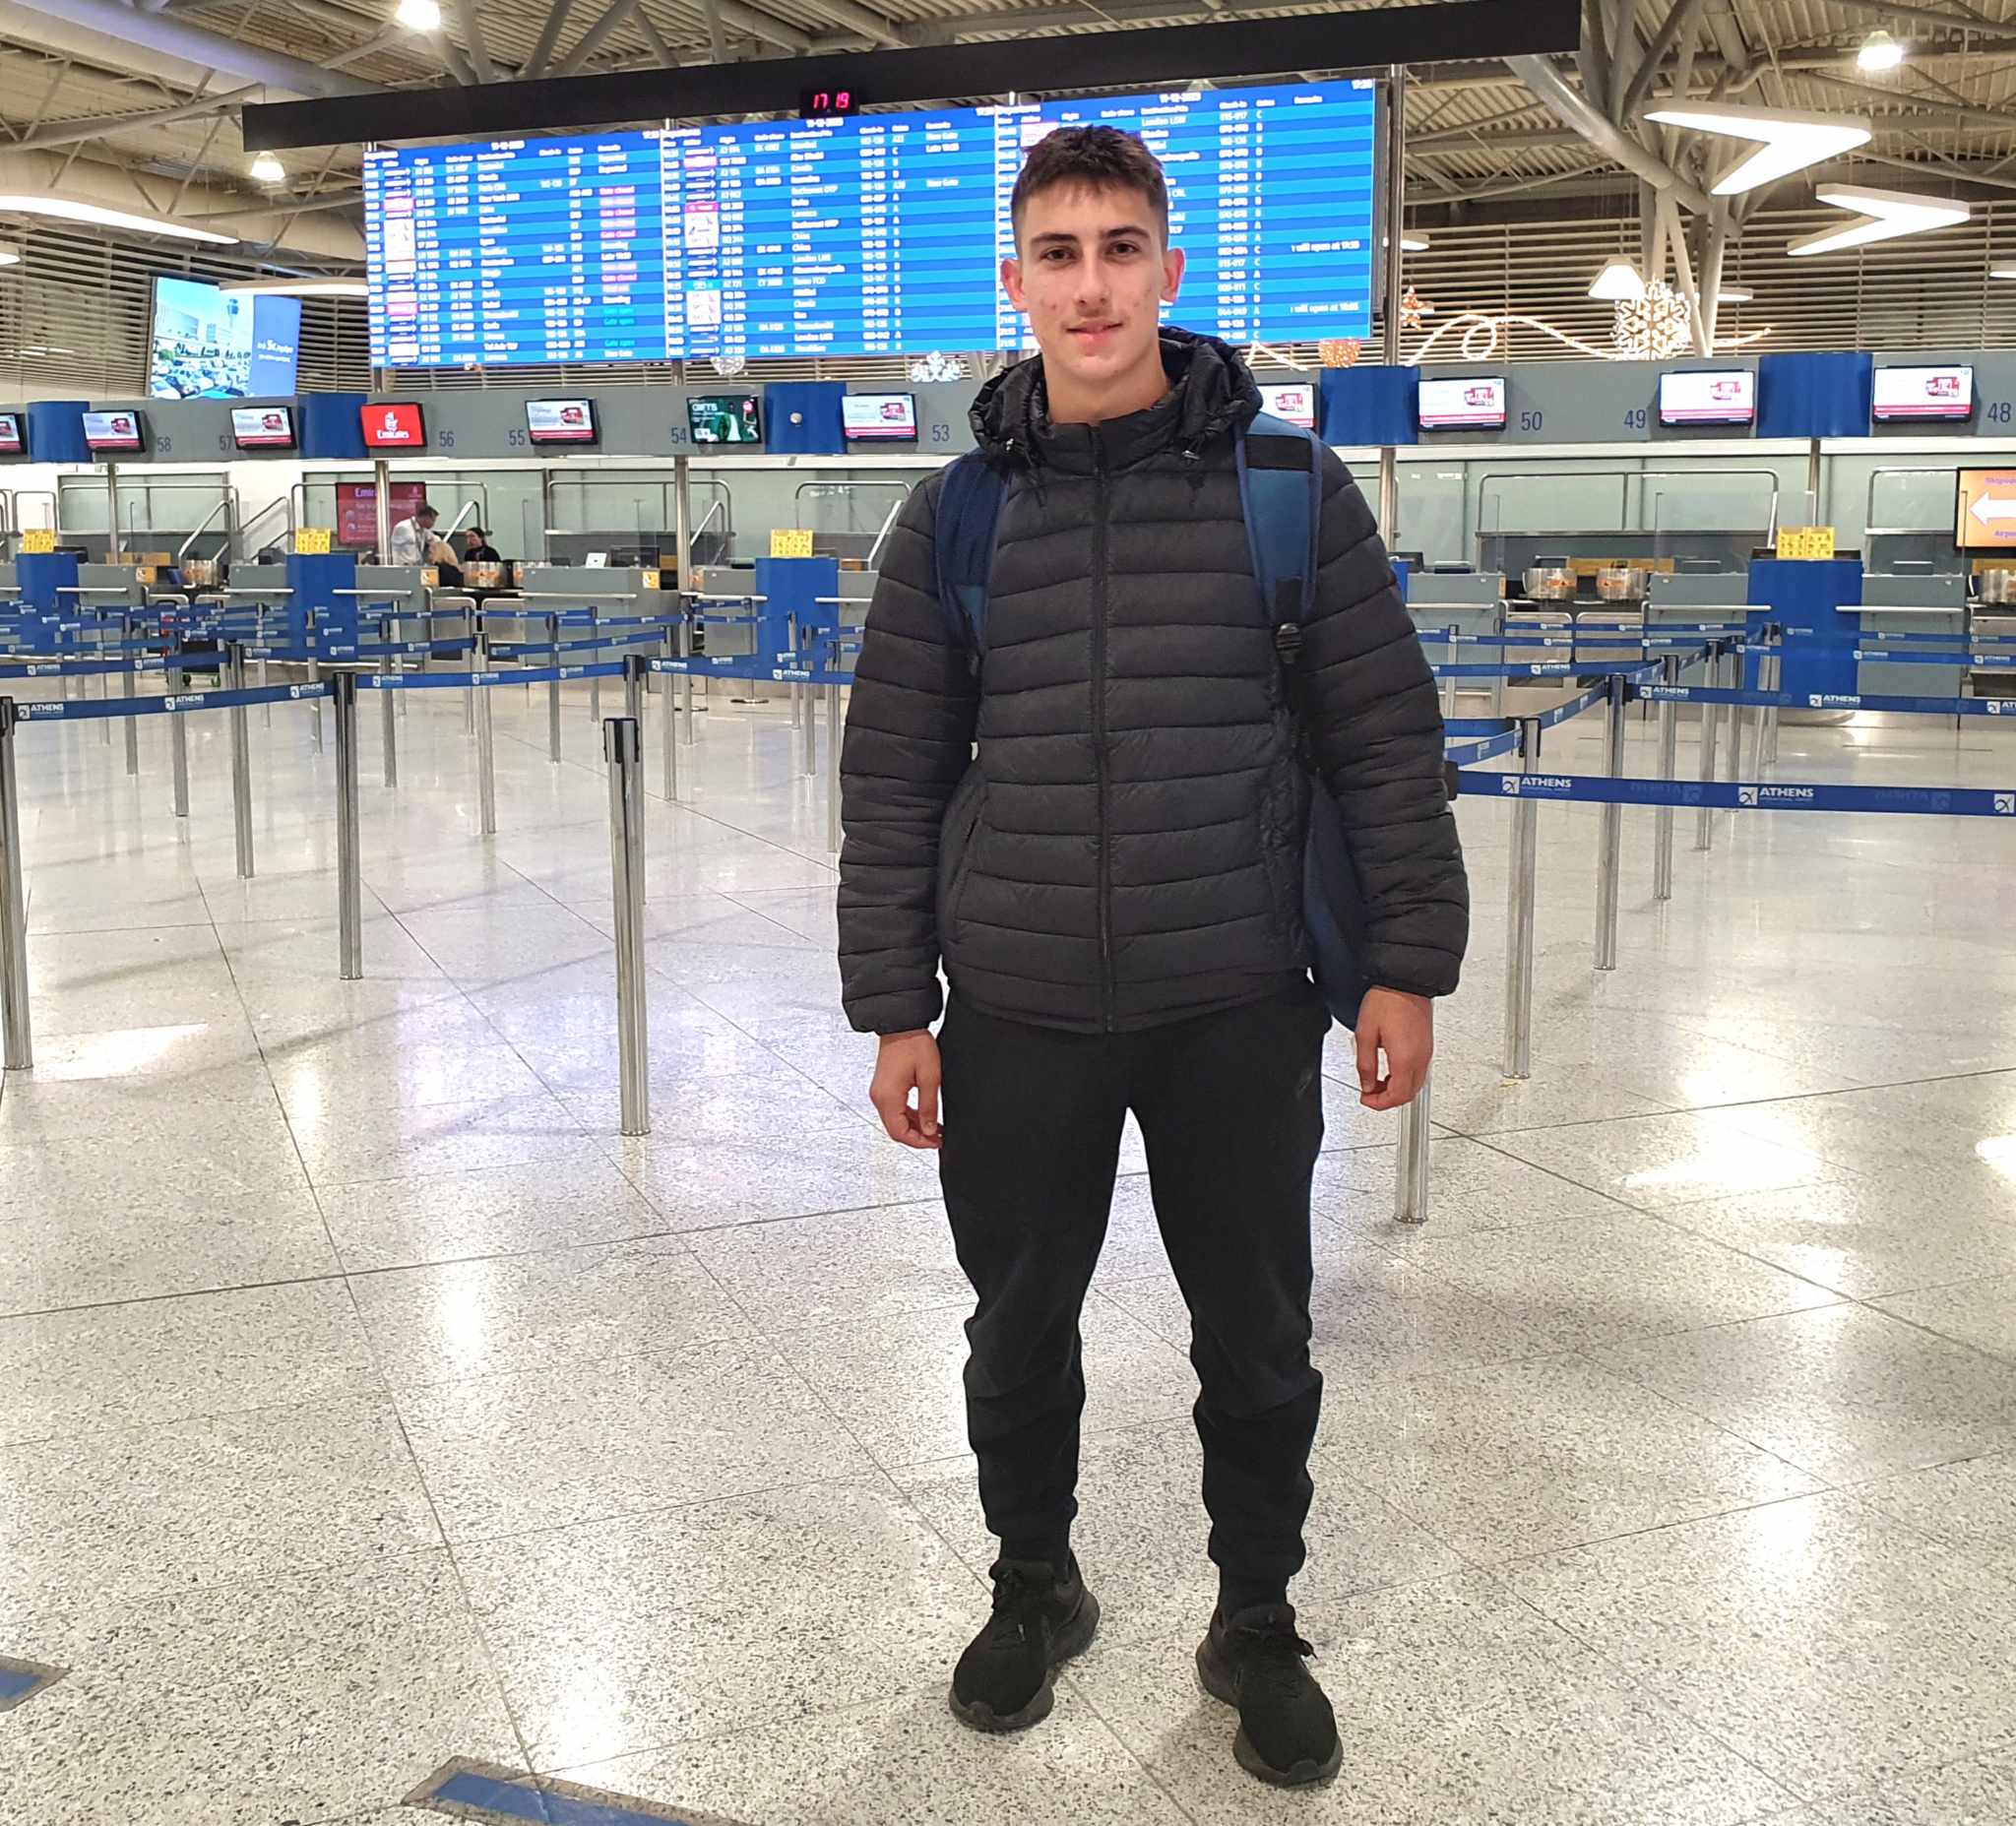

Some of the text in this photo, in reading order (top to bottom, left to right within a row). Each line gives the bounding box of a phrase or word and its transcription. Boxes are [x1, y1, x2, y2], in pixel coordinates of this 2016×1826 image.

[1521, 411, 1543, 431] 50
[1624, 409, 1646, 429] 49
[1986, 402, 2012, 423] 48
[440, 430, 454, 447] 56
[509, 429, 525, 446] 55
[670, 427, 687, 444] 54
[932, 424, 950, 442] 53
[158, 436, 171, 452] 58
[220, 435, 232, 450] 57
[1653, 686, 1690, 695] ATHENS
[1823, 694, 1860, 703] ATHENS
[1521, 777, 1572, 788] ATHENS
[1759, 787, 1814, 798] ATHENS
